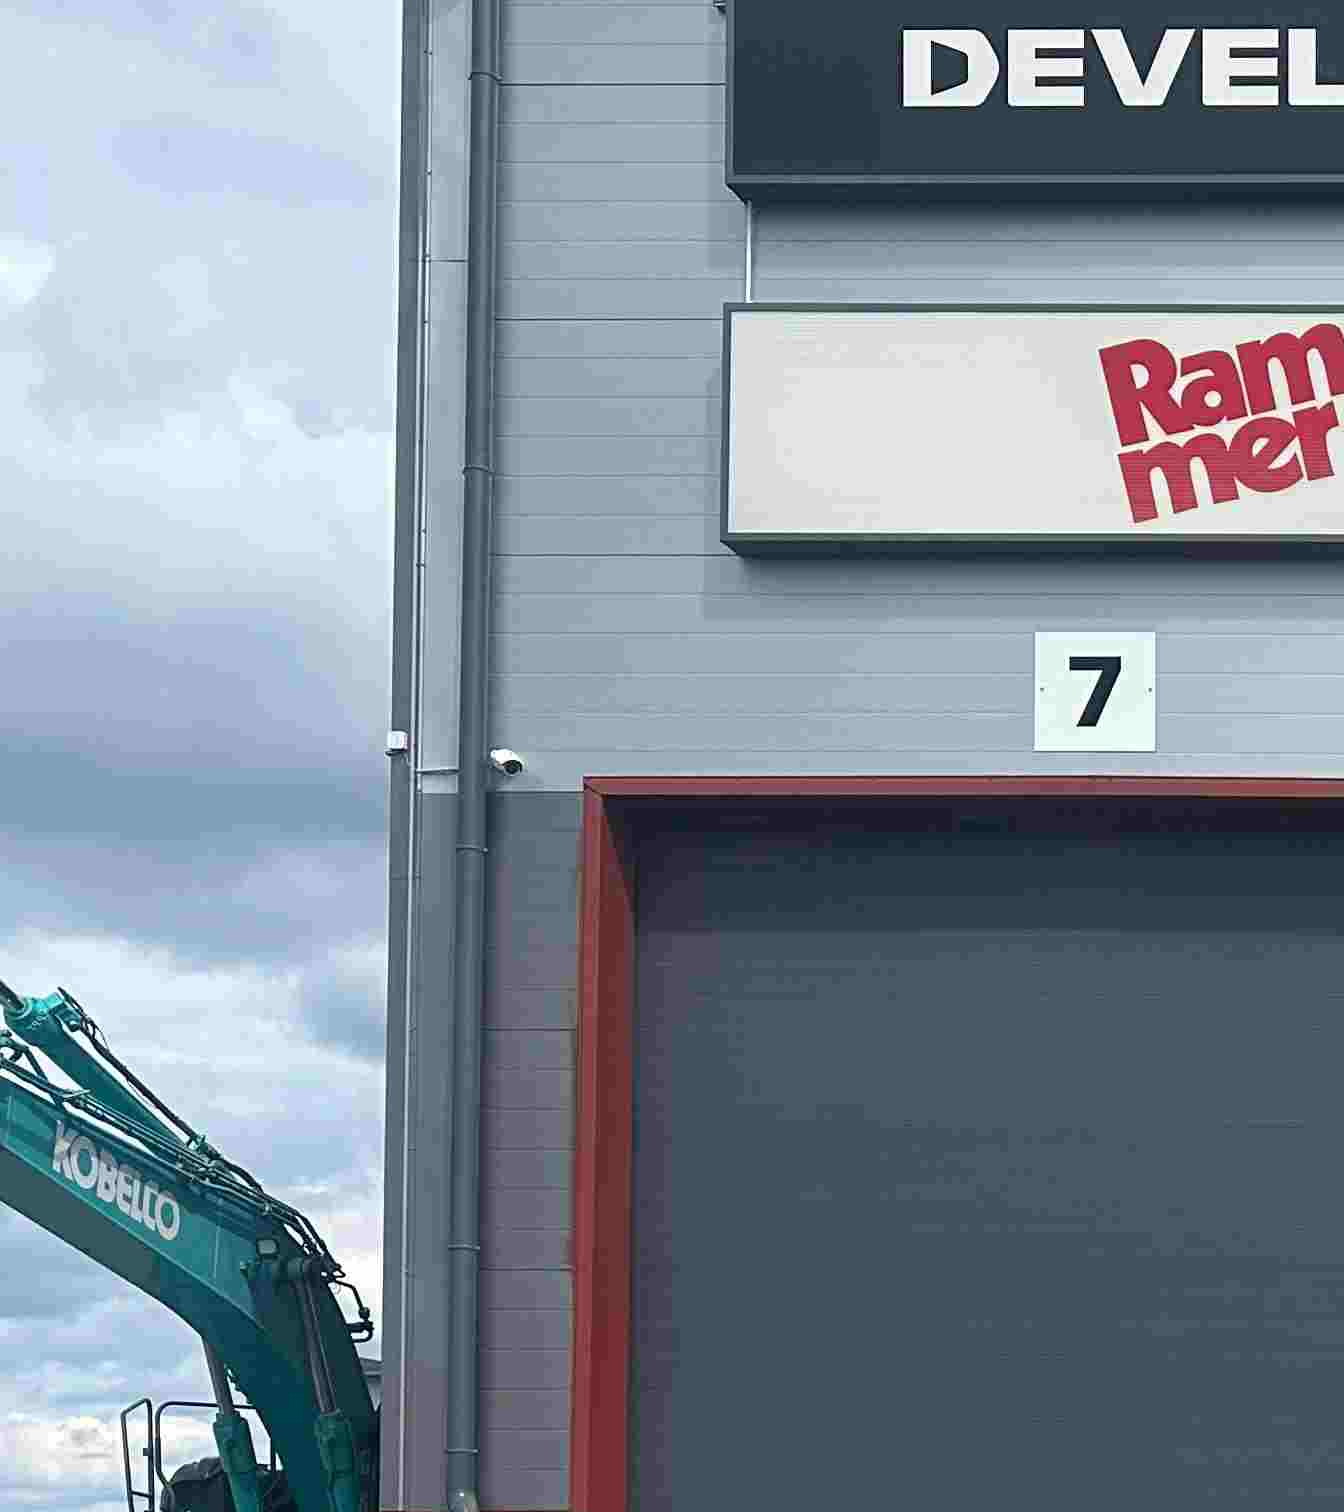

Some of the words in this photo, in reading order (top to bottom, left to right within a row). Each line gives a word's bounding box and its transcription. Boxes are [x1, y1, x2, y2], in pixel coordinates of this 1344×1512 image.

[1117, 402, 1340, 523] mer
[1068, 656, 1122, 727] 7
[52, 1120, 180, 1241] KOBELCO
